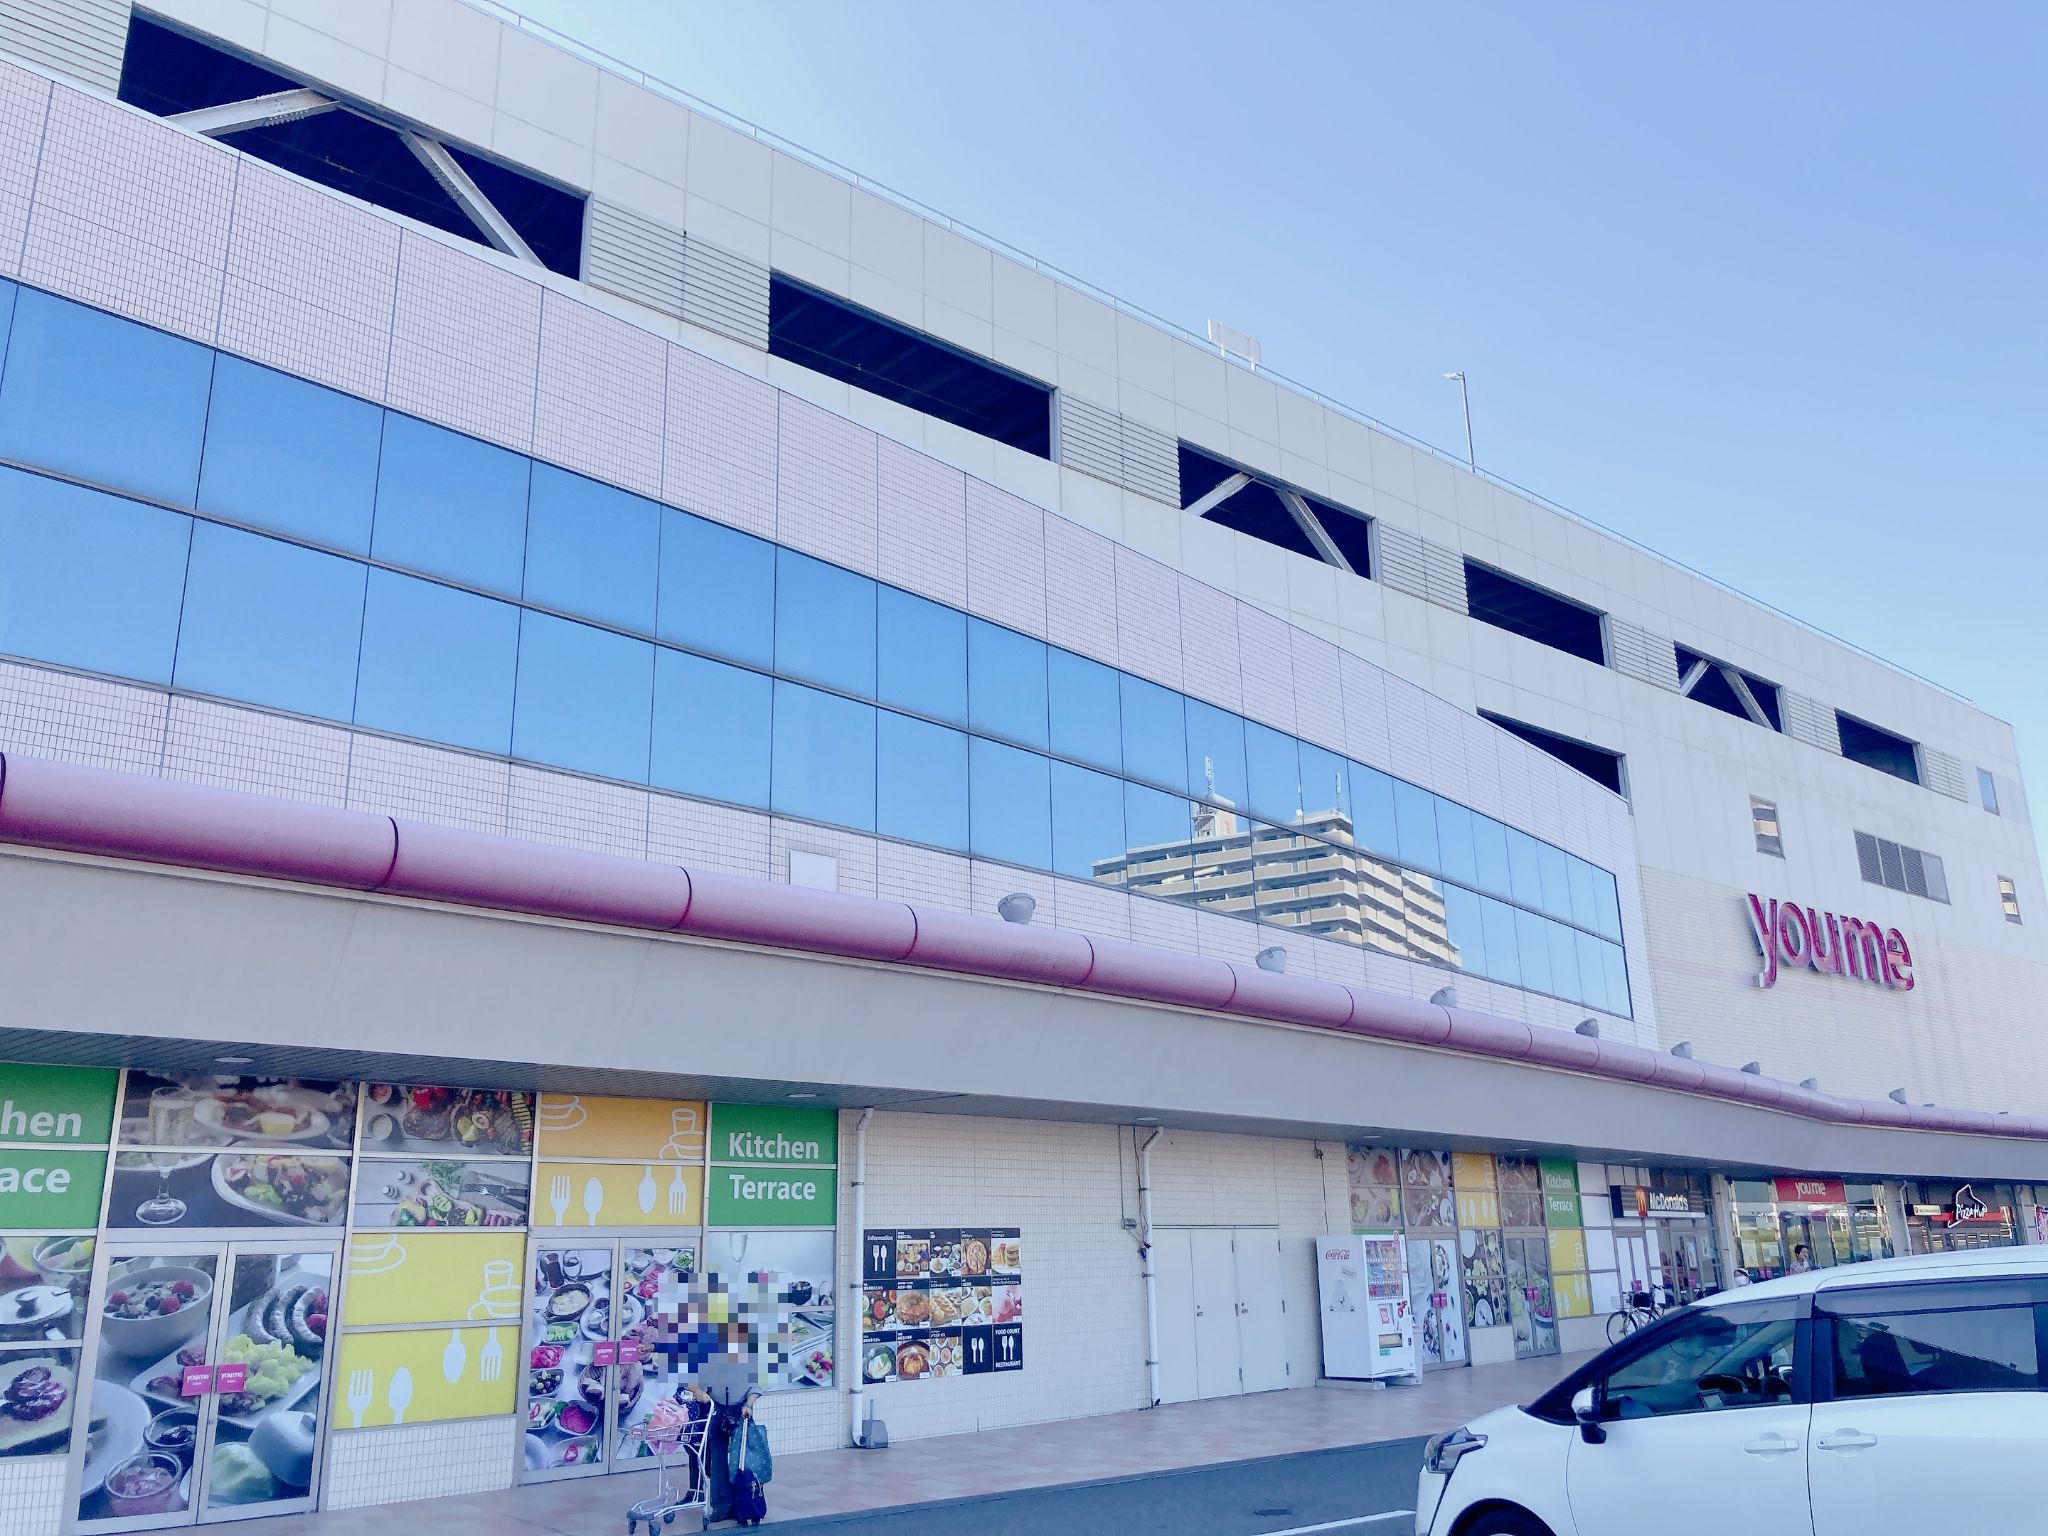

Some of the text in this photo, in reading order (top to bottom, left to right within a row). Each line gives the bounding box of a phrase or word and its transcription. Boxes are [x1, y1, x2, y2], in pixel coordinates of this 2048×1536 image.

[1747, 892, 1915, 991] youme
[0, 1100, 82, 1137] hen
[728, 1131, 819, 1160] Kitchen
[728, 1174, 817, 1200] Terrace
[1545, 1173, 1572, 1189] Kitchen
[1795, 1181, 1826, 1200] youme
[1548, 1196, 1574, 1212] Terrace
[1649, 1191, 1689, 1211] McDonald's
[1956, 1203, 1974, 1221] Pizza
[995, 1360, 1021, 1368] RESTAURANT
